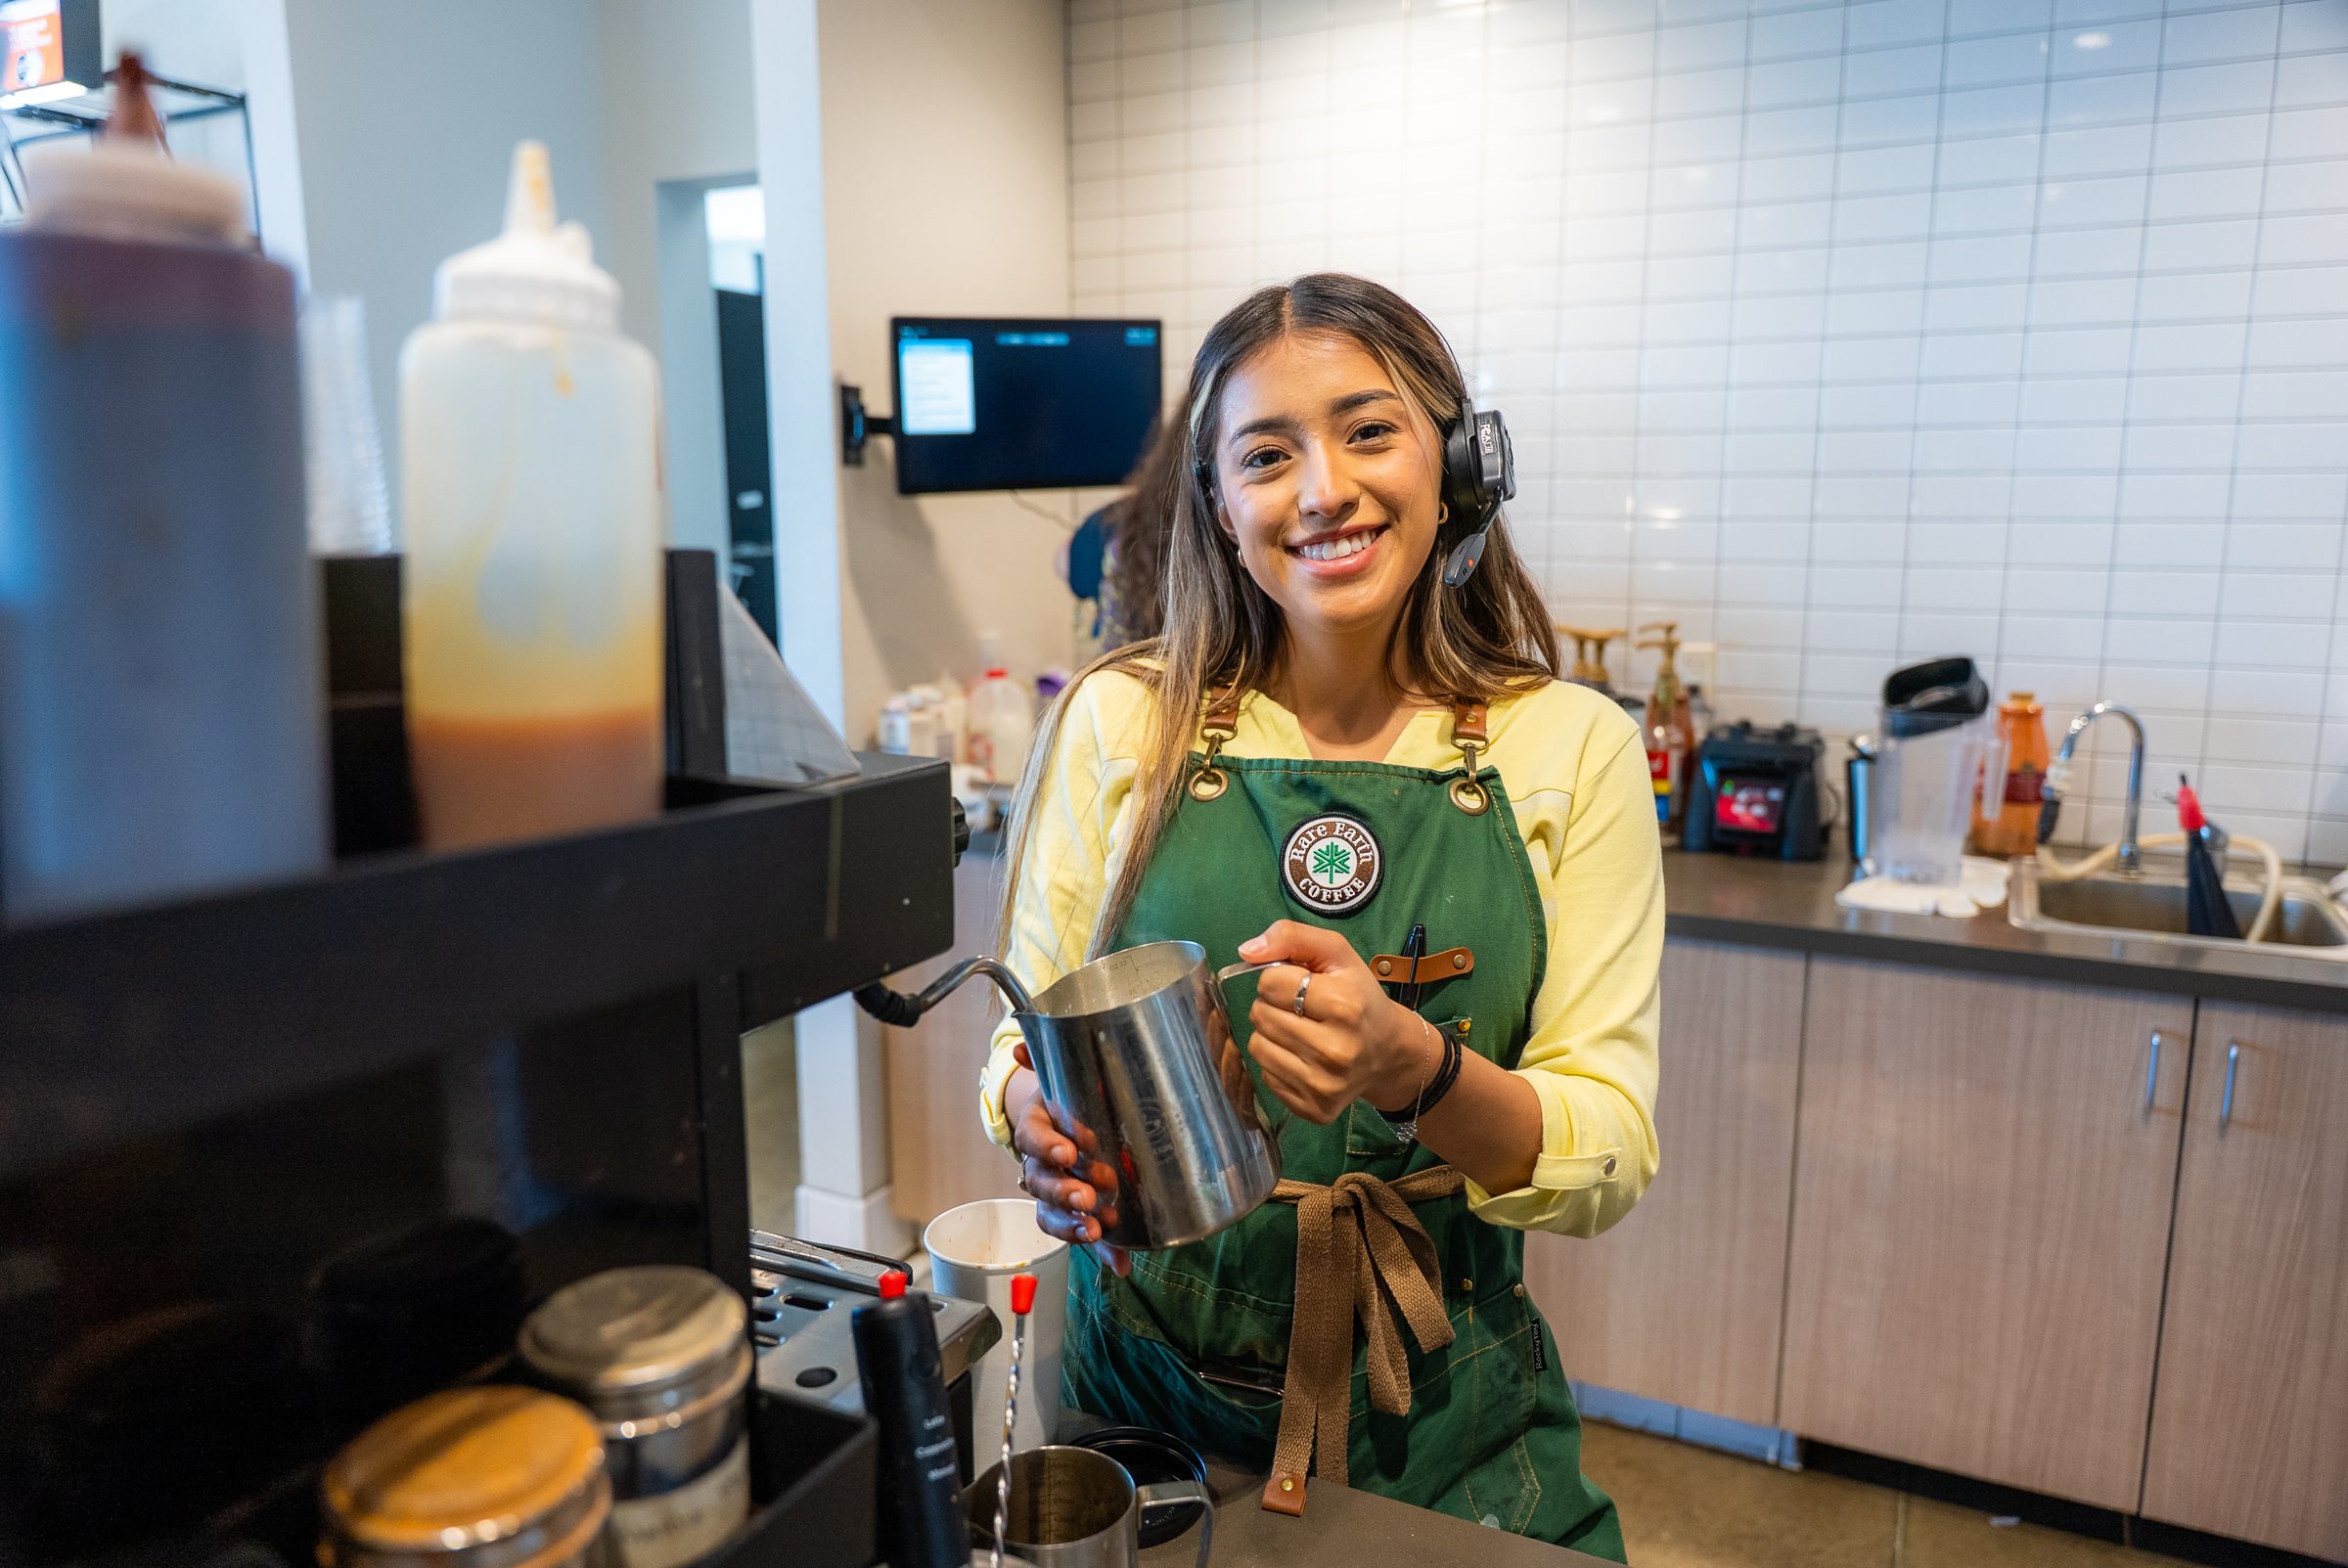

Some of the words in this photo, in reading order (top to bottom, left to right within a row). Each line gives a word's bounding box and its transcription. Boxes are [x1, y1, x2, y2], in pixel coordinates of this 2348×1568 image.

[1290, 824, 1328, 863] Rare
[1333, 822, 1374, 865] Earth
[1299, 877, 1365, 902] COFFEE
